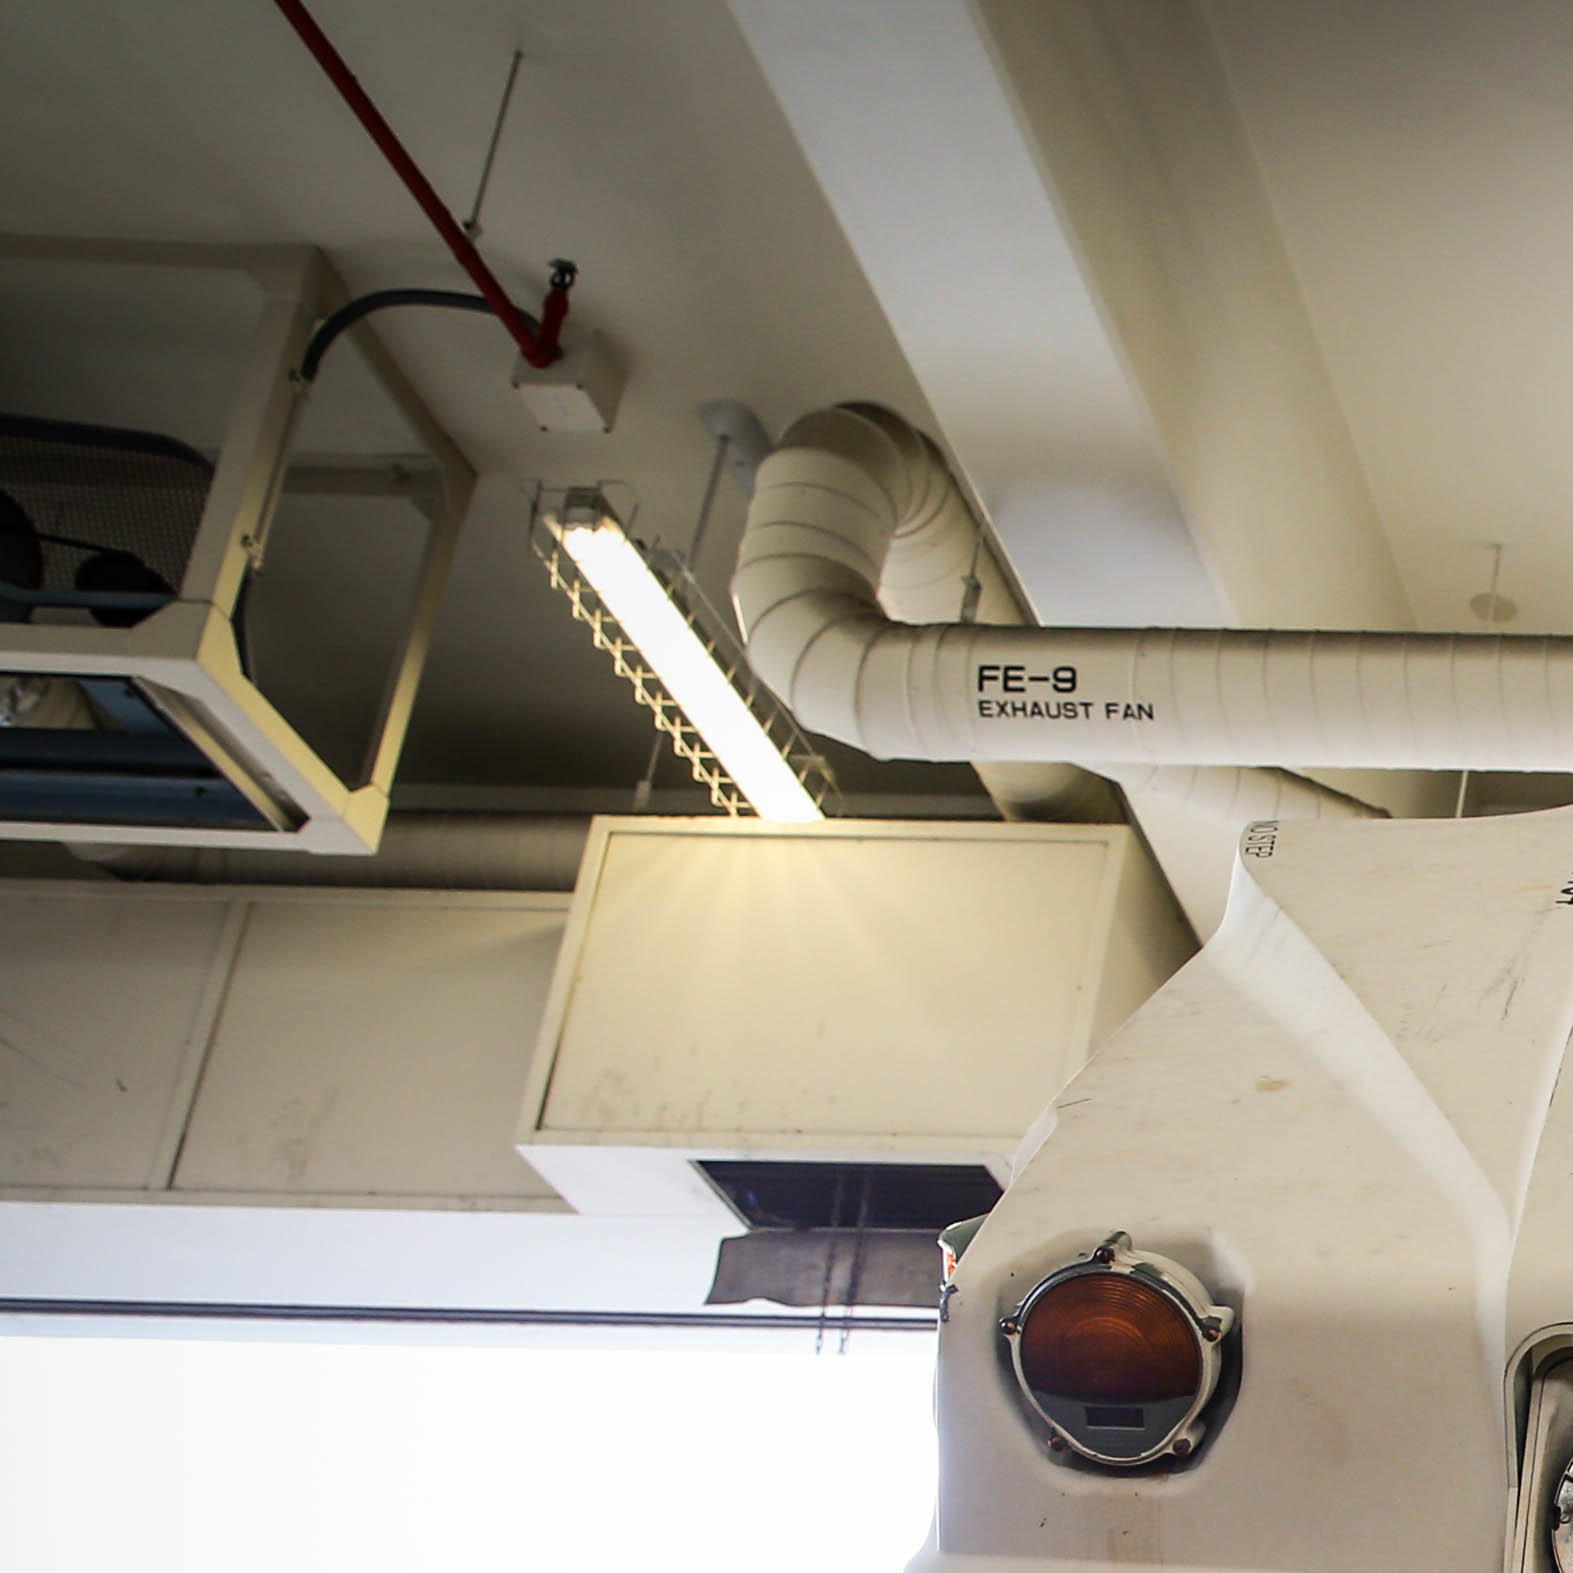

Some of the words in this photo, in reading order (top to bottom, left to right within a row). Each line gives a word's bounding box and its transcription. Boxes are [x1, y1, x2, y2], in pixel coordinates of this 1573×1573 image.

[977, 665, 1078, 693] FE-9
[978, 700, 1094, 720] EXHAUST
[1105, 702, 1155, 721] FAN
[1244, 834, 1278, 859] STEP
